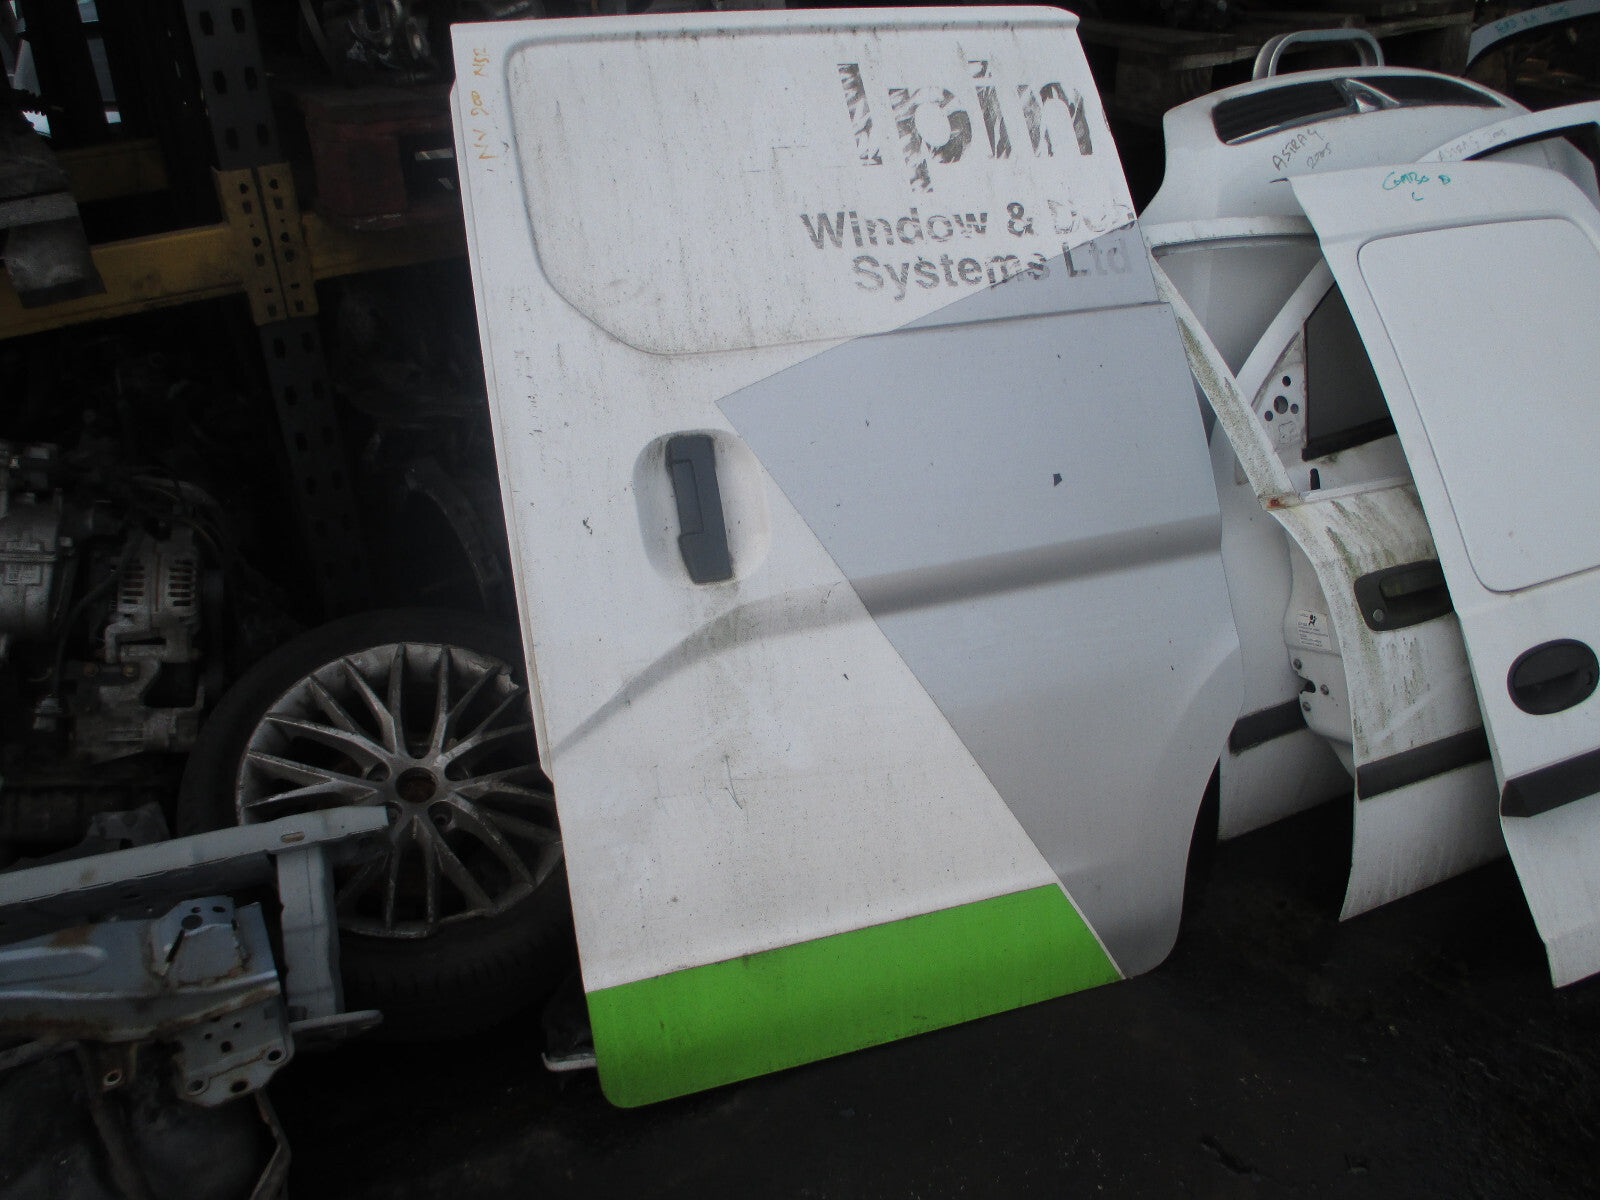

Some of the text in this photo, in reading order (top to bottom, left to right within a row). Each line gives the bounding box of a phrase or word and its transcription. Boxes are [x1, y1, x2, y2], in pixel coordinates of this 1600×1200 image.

[800, 207, 988, 250] Window
[1006, 202, 1036, 237] &
[852, 252, 1051, 301] Systems
